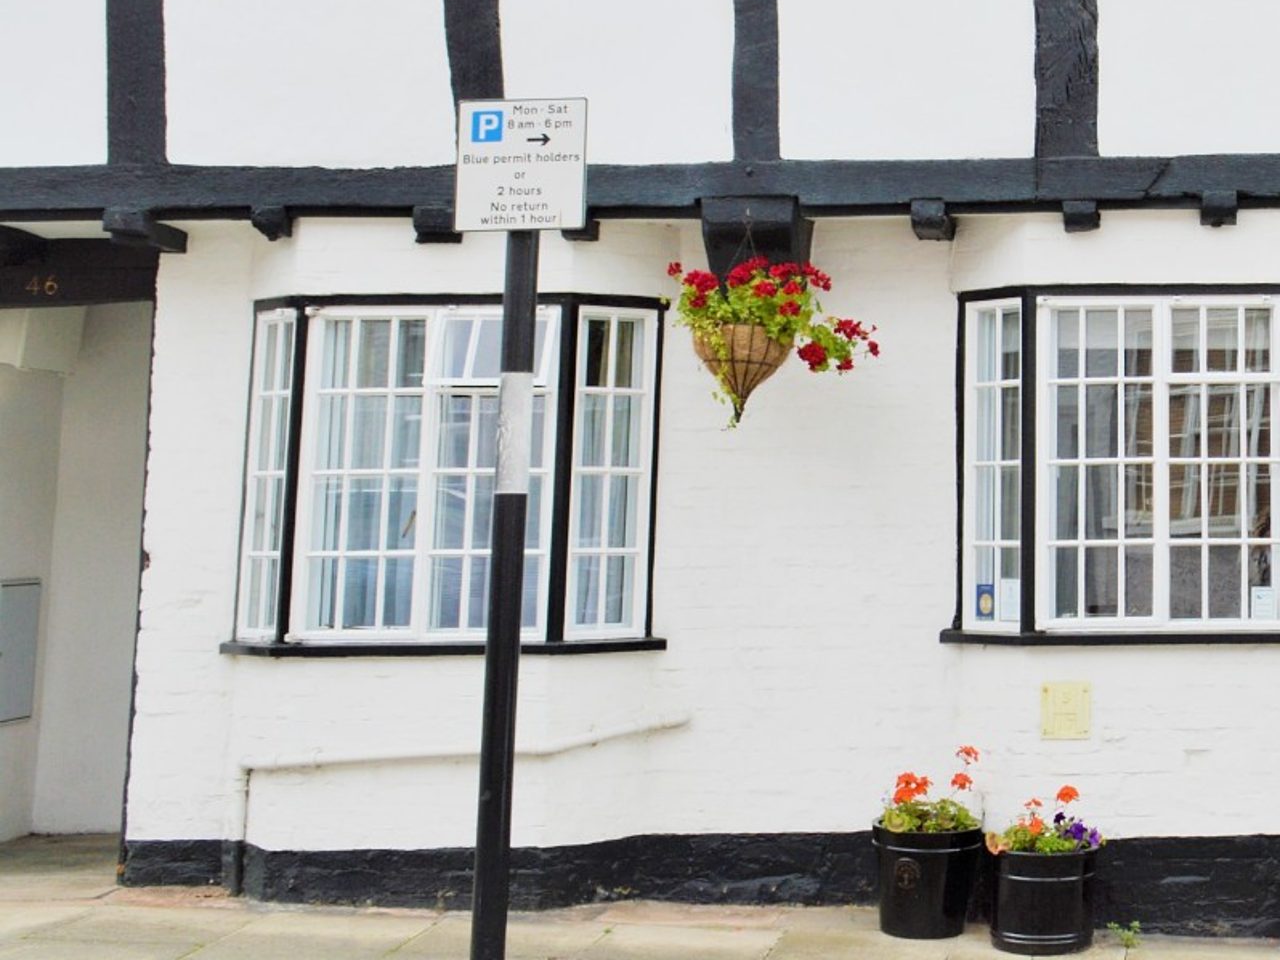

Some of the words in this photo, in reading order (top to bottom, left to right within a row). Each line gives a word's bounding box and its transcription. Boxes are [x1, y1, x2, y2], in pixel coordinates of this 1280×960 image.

[513, 105, 538, 115] Mon
[548, 104, 568, 114] Sat
[478, 113, 499, 140] P
[507, 119, 515, 130] 8
[518, 121, 535, 129] am
[544, 119, 552, 129] 6
[554, 120, 573, 130] pm
[463, 154, 489, 165] Blue
[493, 153, 532, 165] permit
[537, 152, 580, 163] holders
[514, 171, 526, 180] or
[497, 186, 505, 196] 2
[509, 186, 542, 196] hours
[490, 202, 507, 212] No
[511, 202, 549, 212] return
[480, 215, 517, 225] within
[520, 214, 526, 223] 1
[530, 213, 556, 223] hour
[24, 275, 58, 296] 46
